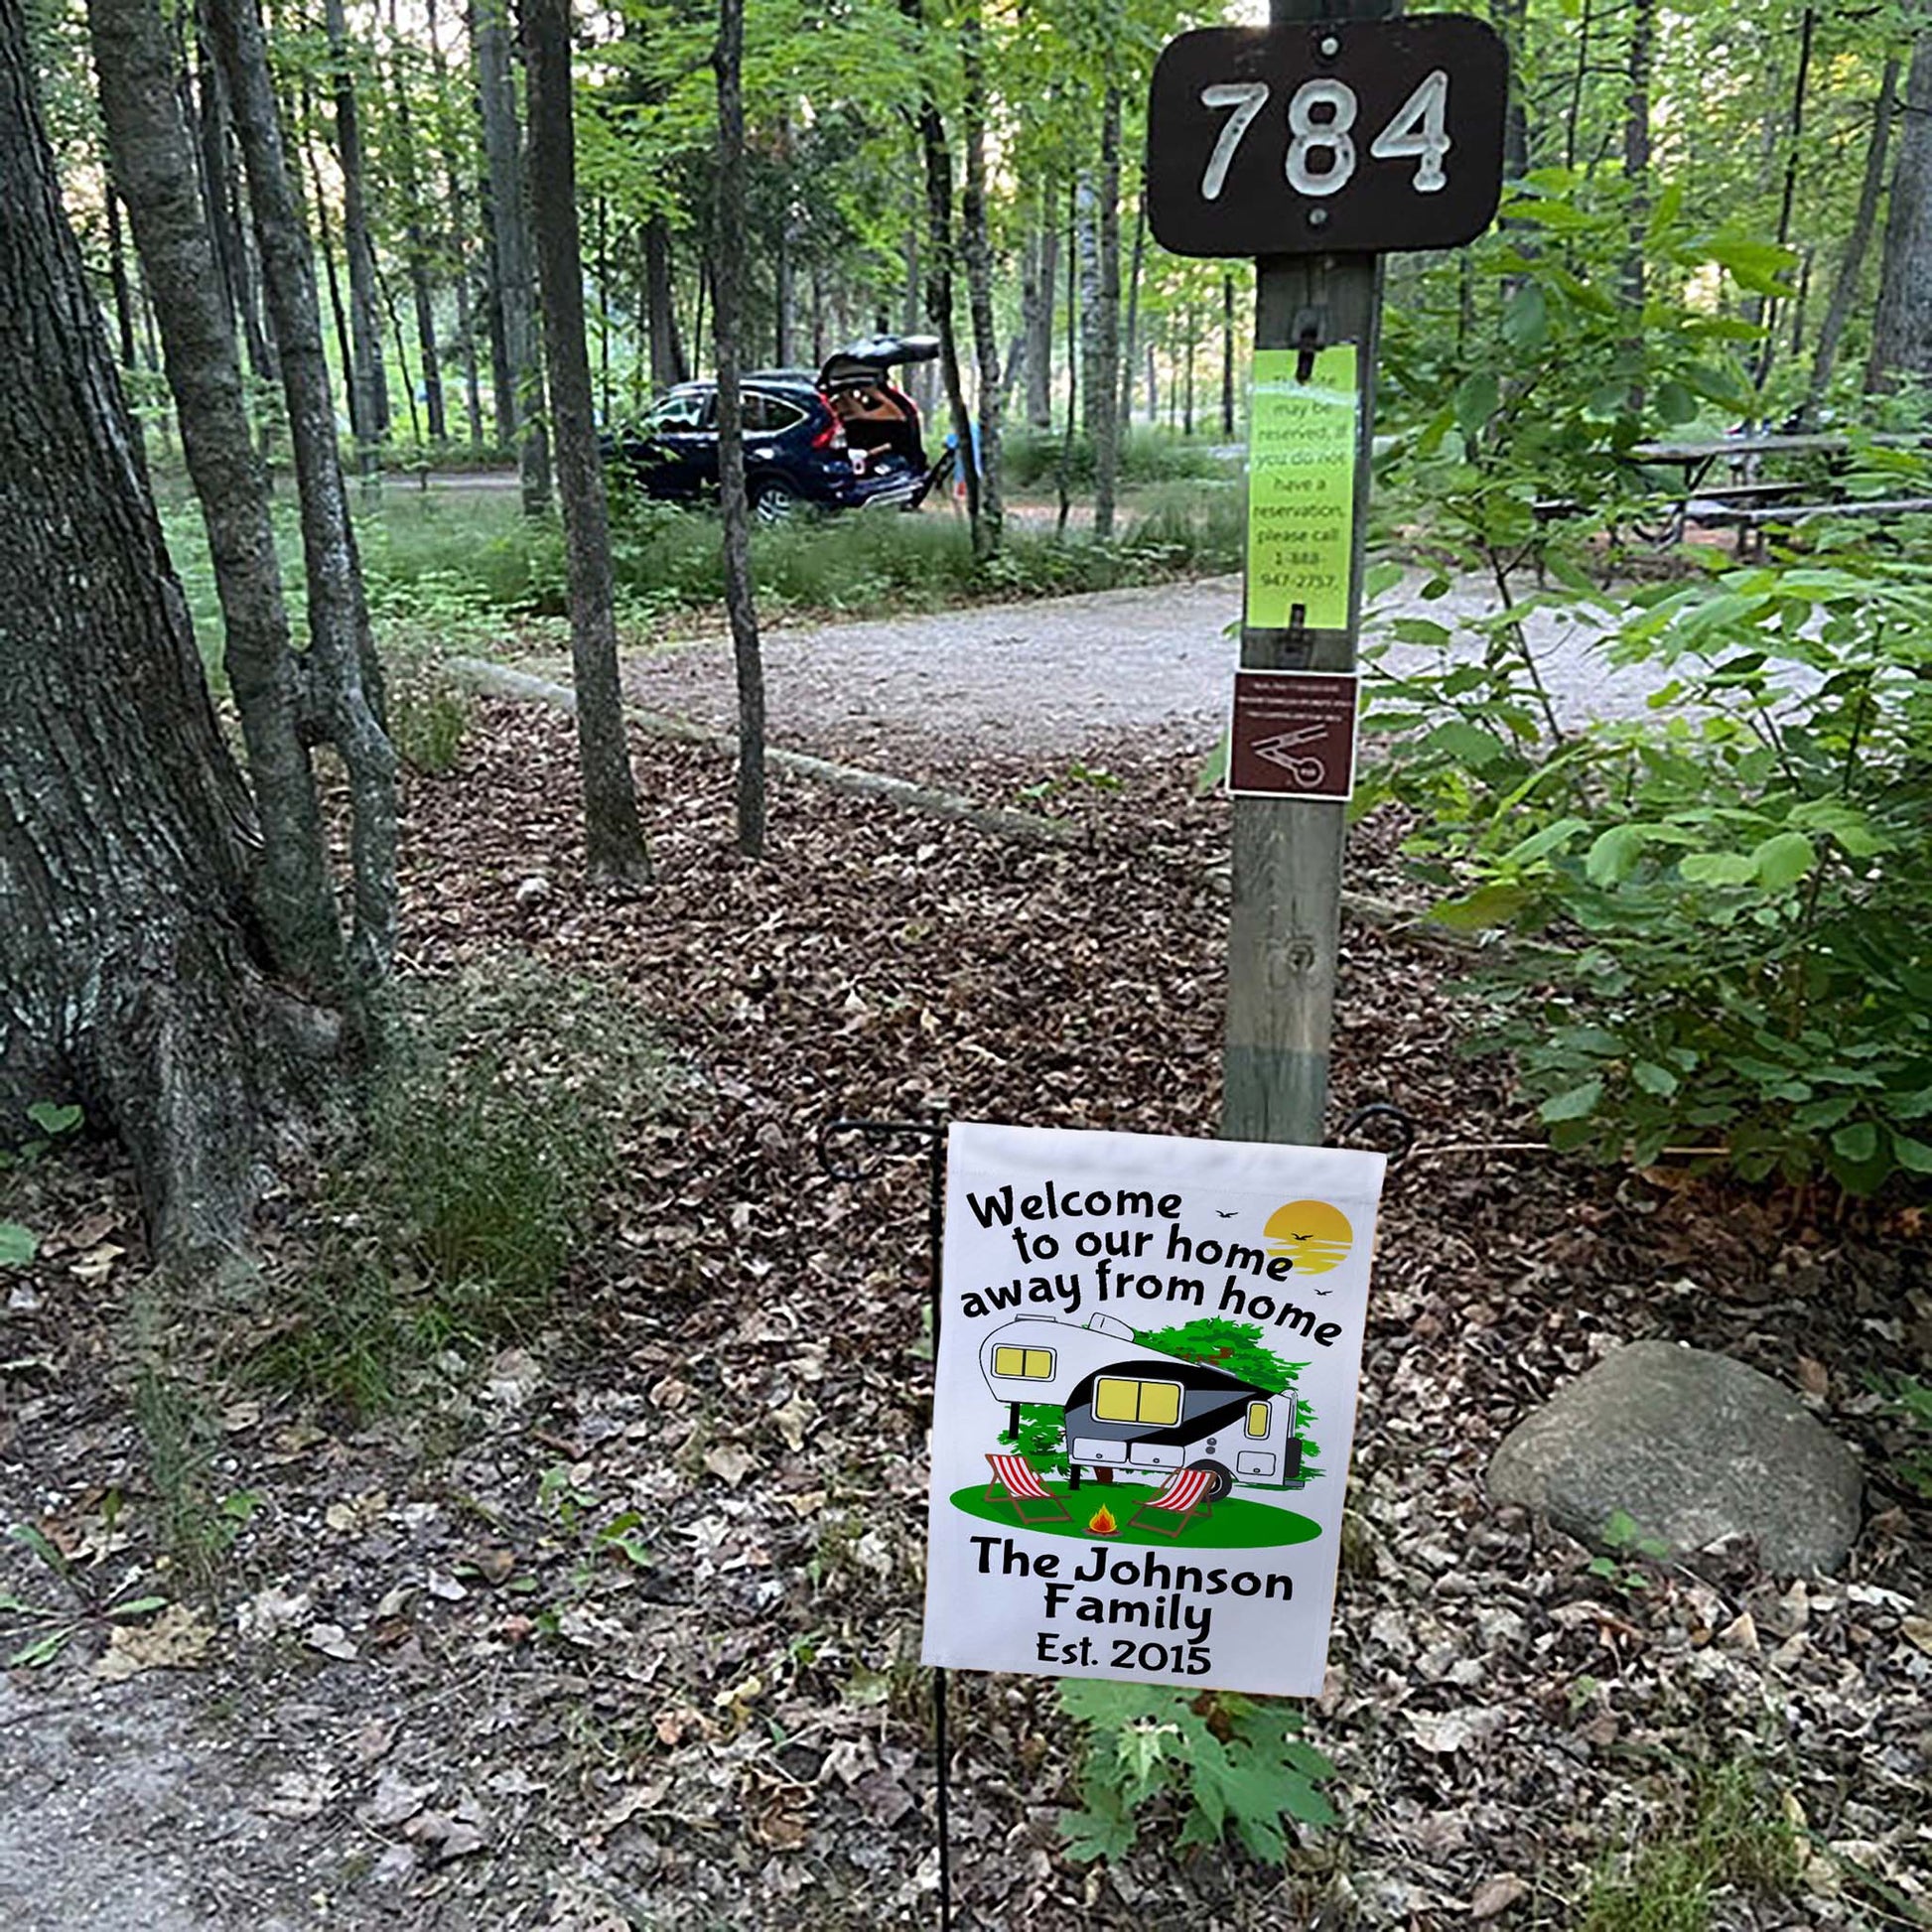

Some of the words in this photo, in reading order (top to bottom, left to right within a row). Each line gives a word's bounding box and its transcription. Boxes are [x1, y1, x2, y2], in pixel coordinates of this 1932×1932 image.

[1200, 69, 1451, 201] 784
[1273, 403, 1308, 420] may
[1311, 401, 1332, 415] be
[1255, 452, 1288, 471] you
[1290, 449, 1315, 467] do
[1316, 451, 1347, 468] not
[1272, 477, 1313, 493] have
[1315, 478, 1327, 492] a
[1256, 526, 1309, 545] please
[1311, 525, 1340, 542] call
[966, 1180, 1183, 1230] Welcome
[1012, 1226, 1059, 1265] to
[1075, 1229, 1154, 1258] our
[1166, 1222, 1294, 1282] home
[960, 1274, 1081, 1319] away
[1095, 1258, 1204, 1307] from
[1218, 1274, 1342, 1347] home
[970, 1536, 1060, 1579] The
[1074, 1546, 1293, 1601] Johnson
[1043, 1582, 1212, 1646] Family
[1035, 1632, 1099, 1667] Est.
[1110, 1639, 1212, 1676] 2015
